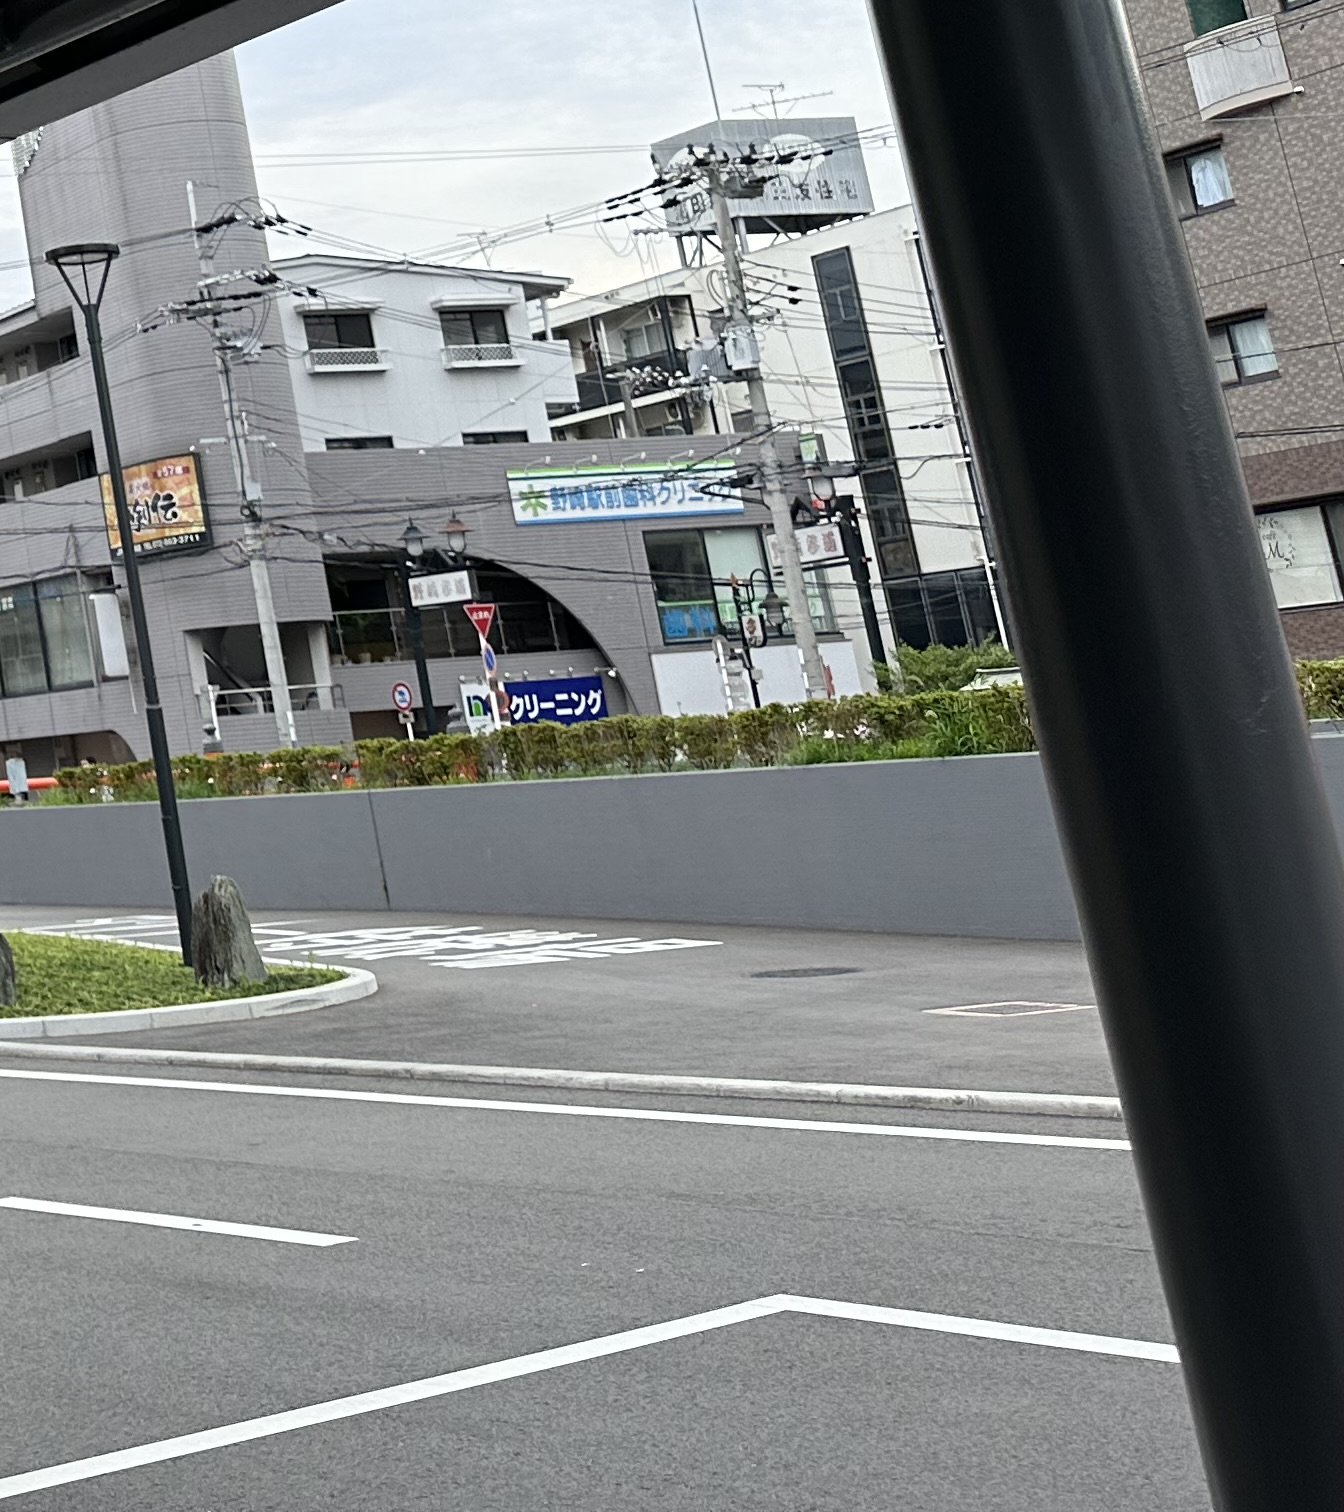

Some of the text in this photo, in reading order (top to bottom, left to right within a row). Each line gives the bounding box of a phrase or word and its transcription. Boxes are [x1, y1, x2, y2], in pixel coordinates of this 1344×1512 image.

[510, 689, 603, 721] クリーニング
